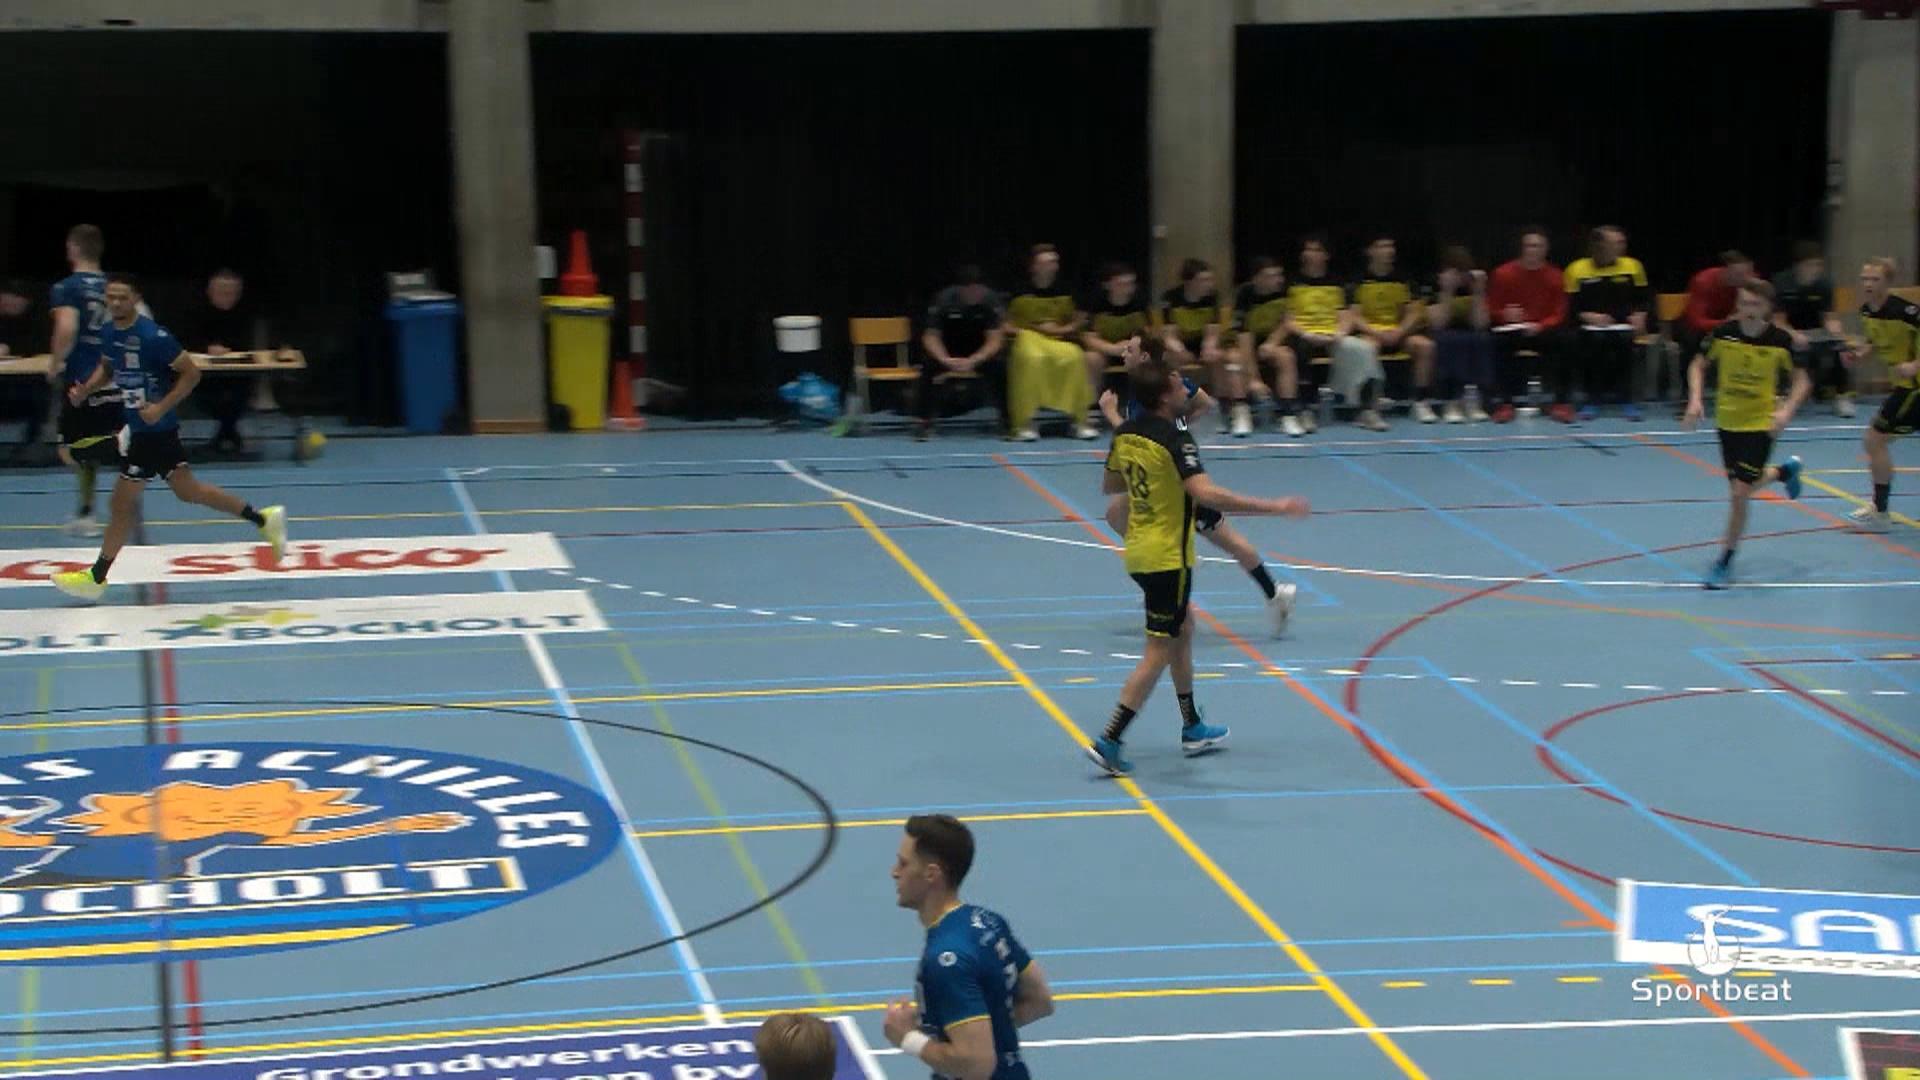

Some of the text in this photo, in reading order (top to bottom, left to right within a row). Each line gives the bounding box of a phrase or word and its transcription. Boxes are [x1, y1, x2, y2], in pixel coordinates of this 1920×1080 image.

[167, 544, 506, 575] stico
[228, 615, 583, 641] BOCHOLT
[162, 748, 592, 850] ACHILLES
[1685, 903, 1920, 953] SA
[256, 1038, 754, 1080] Grondwerken
